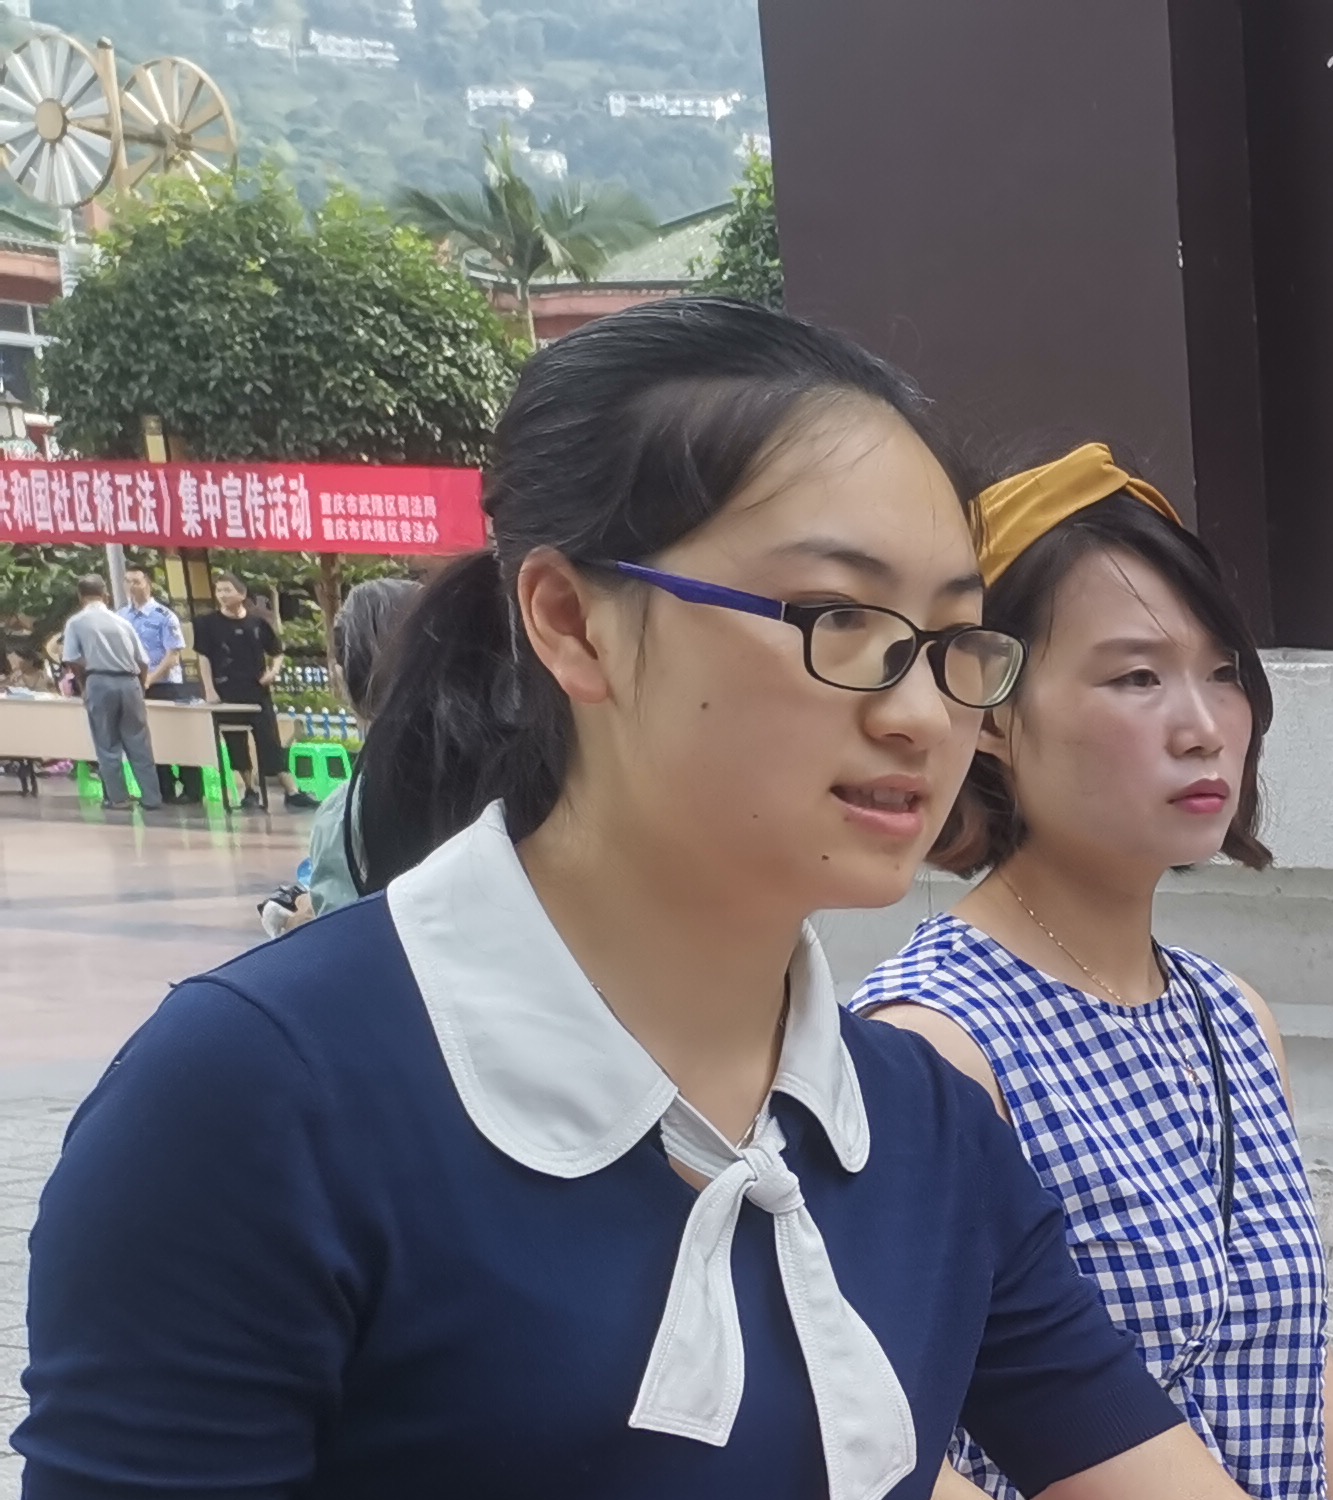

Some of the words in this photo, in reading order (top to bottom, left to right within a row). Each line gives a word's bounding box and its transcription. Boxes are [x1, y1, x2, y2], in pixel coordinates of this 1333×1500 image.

[319, 492, 437, 518] 重庆市武隆区司法局
